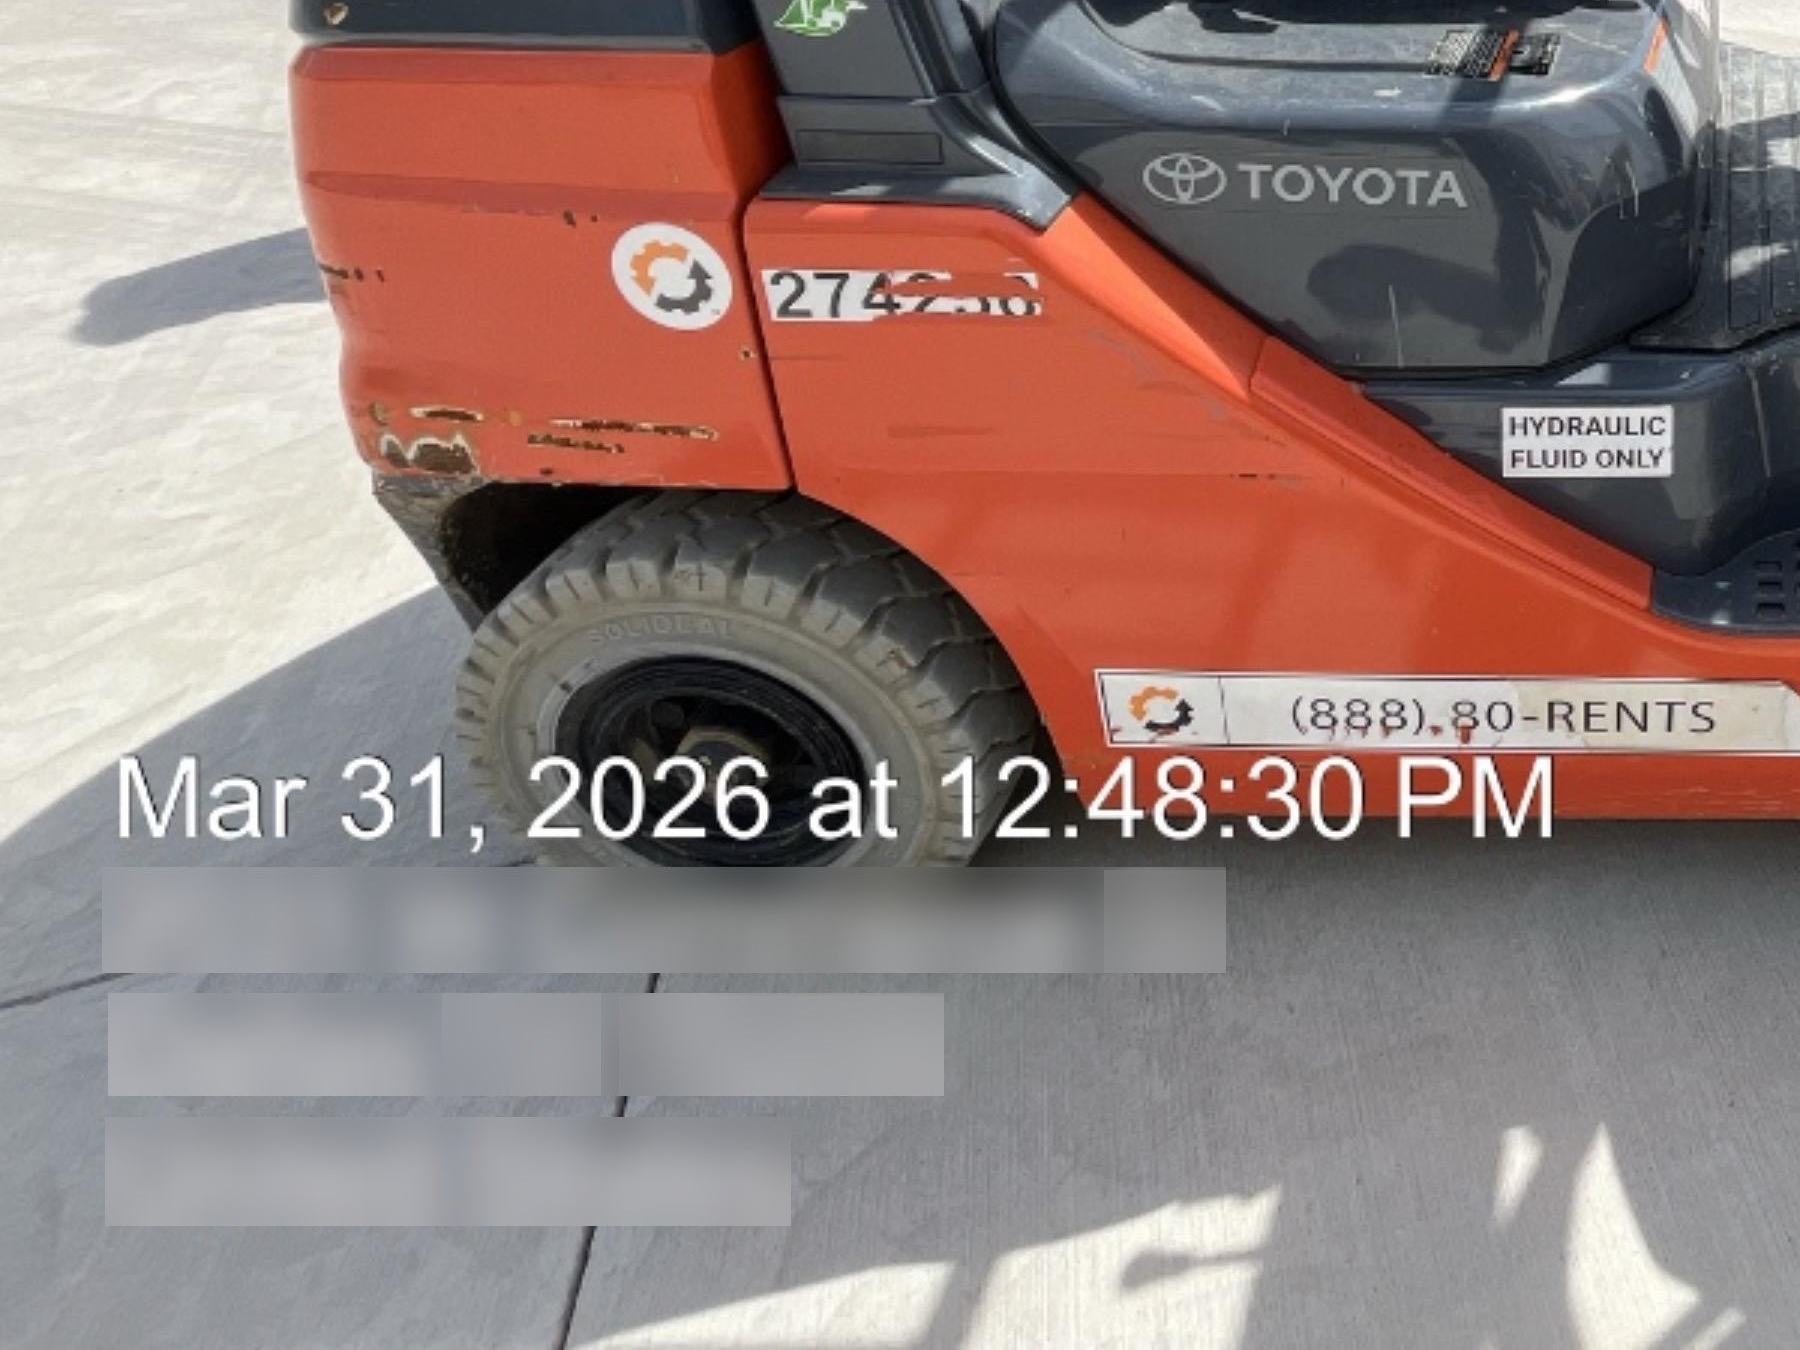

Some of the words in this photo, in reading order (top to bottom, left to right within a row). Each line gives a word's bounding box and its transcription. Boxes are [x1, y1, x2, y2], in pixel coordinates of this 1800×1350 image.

[1237, 162, 1469, 209] TOYOTA
[1508, 416, 1667, 437] HYDRAULIC
[1510, 449, 1588, 469] FLUID
[1595, 447, 1665, 469] ONLY
[1450, 699, 1717, 735] 80-RENTS
